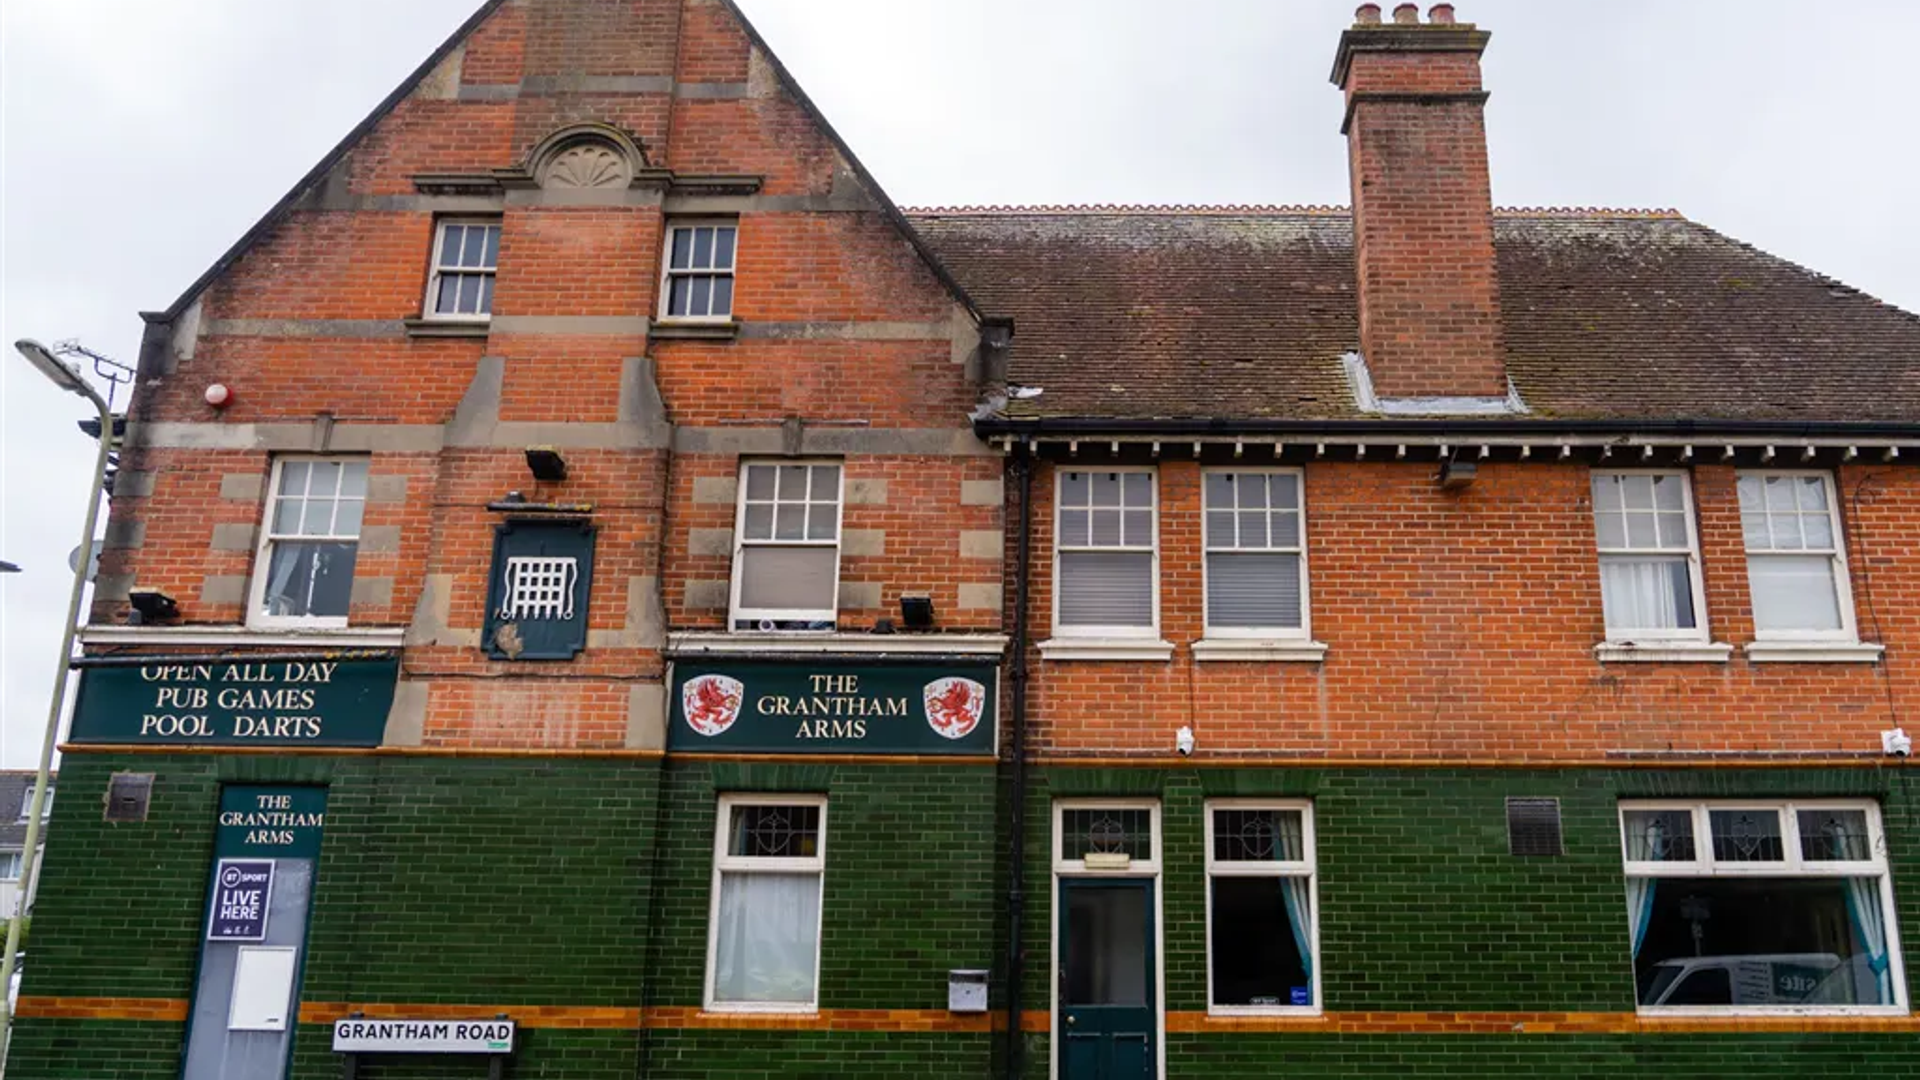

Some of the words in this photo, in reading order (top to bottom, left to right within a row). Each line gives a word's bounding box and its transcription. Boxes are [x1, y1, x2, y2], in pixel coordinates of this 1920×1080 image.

[140, 665, 213, 681] OPEN
[221, 663, 274, 682] ALL
[283, 662, 338, 682] DAY
[809, 674, 858, 693] THE
[155, 687, 208, 708] PUB
[217, 688, 316, 710] GAMES
[757, 695, 908, 715] GRANTHAM
[140, 714, 214, 736] POOL
[232, 715, 322, 738] DARTS
[795, 719, 866, 739] ARMS
[256, 795, 292, 809] THE
[219, 812, 323, 827] GRANTHAM
[244, 830, 294, 844] ARMS
[241, 873, 268, 883] SPORT
[222, 890, 262, 906] LIVE
[220, 905, 259, 920] HERE
[337, 1023, 449, 1040] GRANTHAM
[455, 1024, 510, 1040] ROAD
